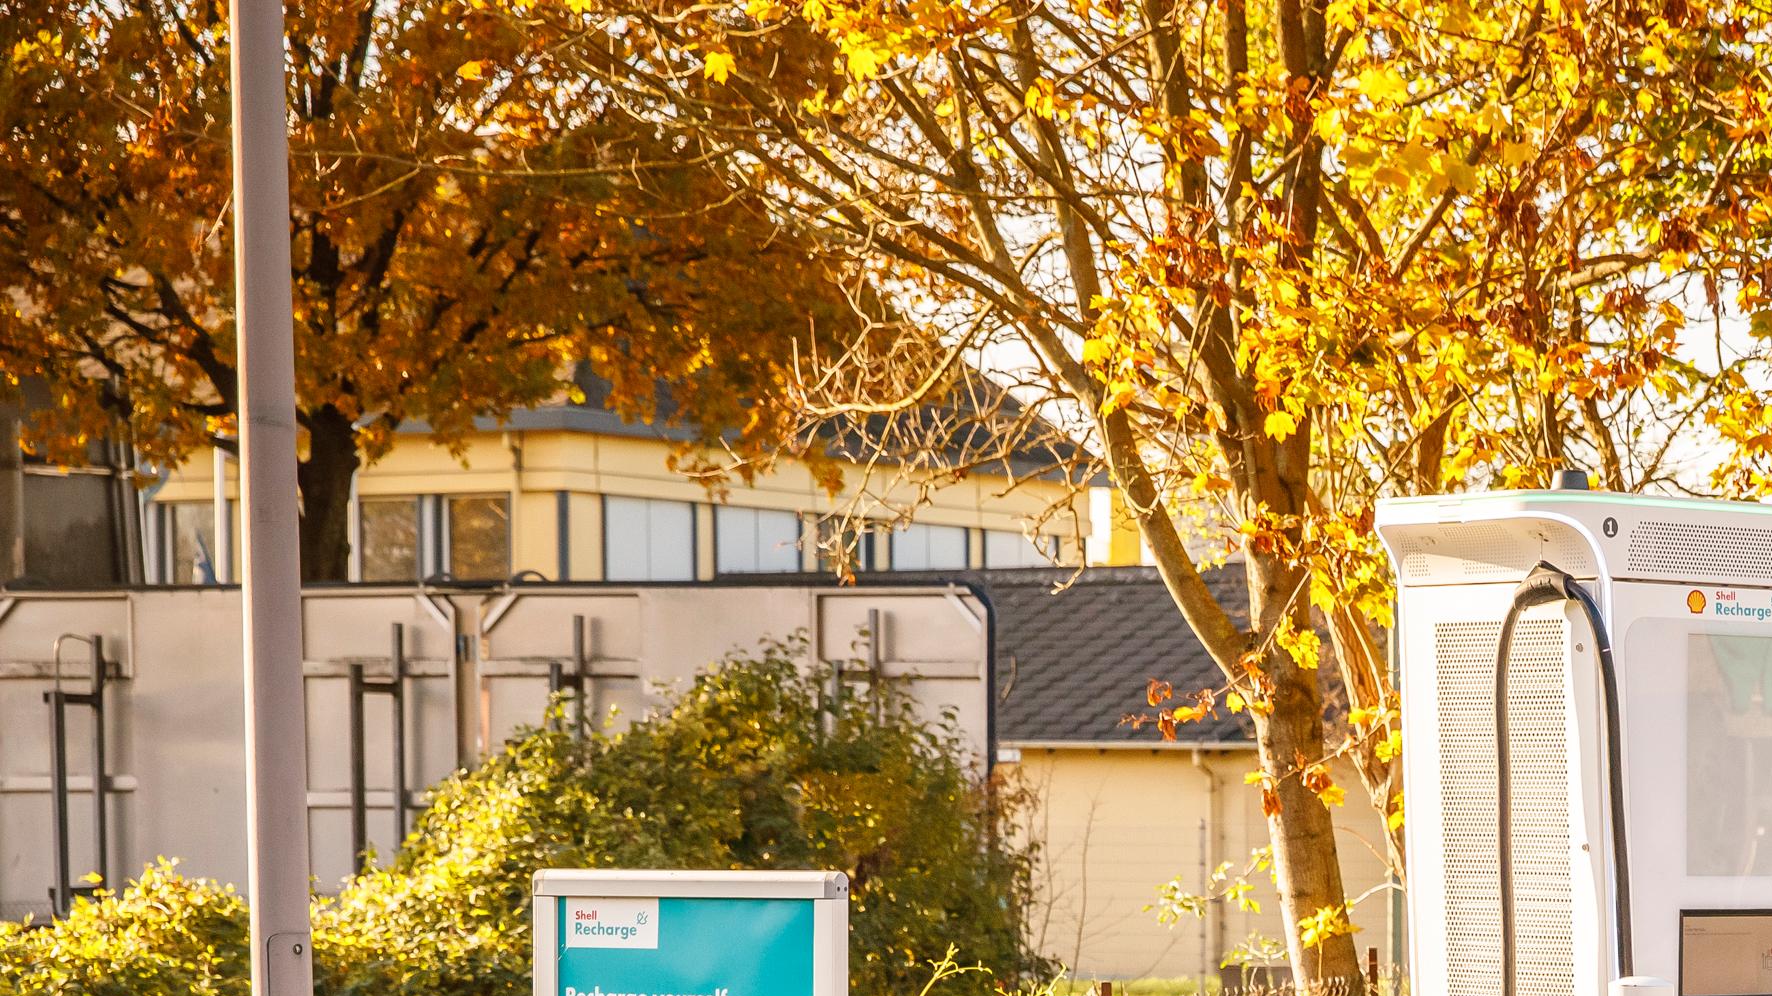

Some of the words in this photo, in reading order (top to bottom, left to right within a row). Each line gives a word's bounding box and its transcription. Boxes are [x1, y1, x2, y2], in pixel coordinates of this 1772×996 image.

[1715, 591, 1736, 601] Shell
[1715, 602, 1772, 621] Recharge
[575, 910, 597, 920] Shell
[575, 921, 637, 940] Recharge
